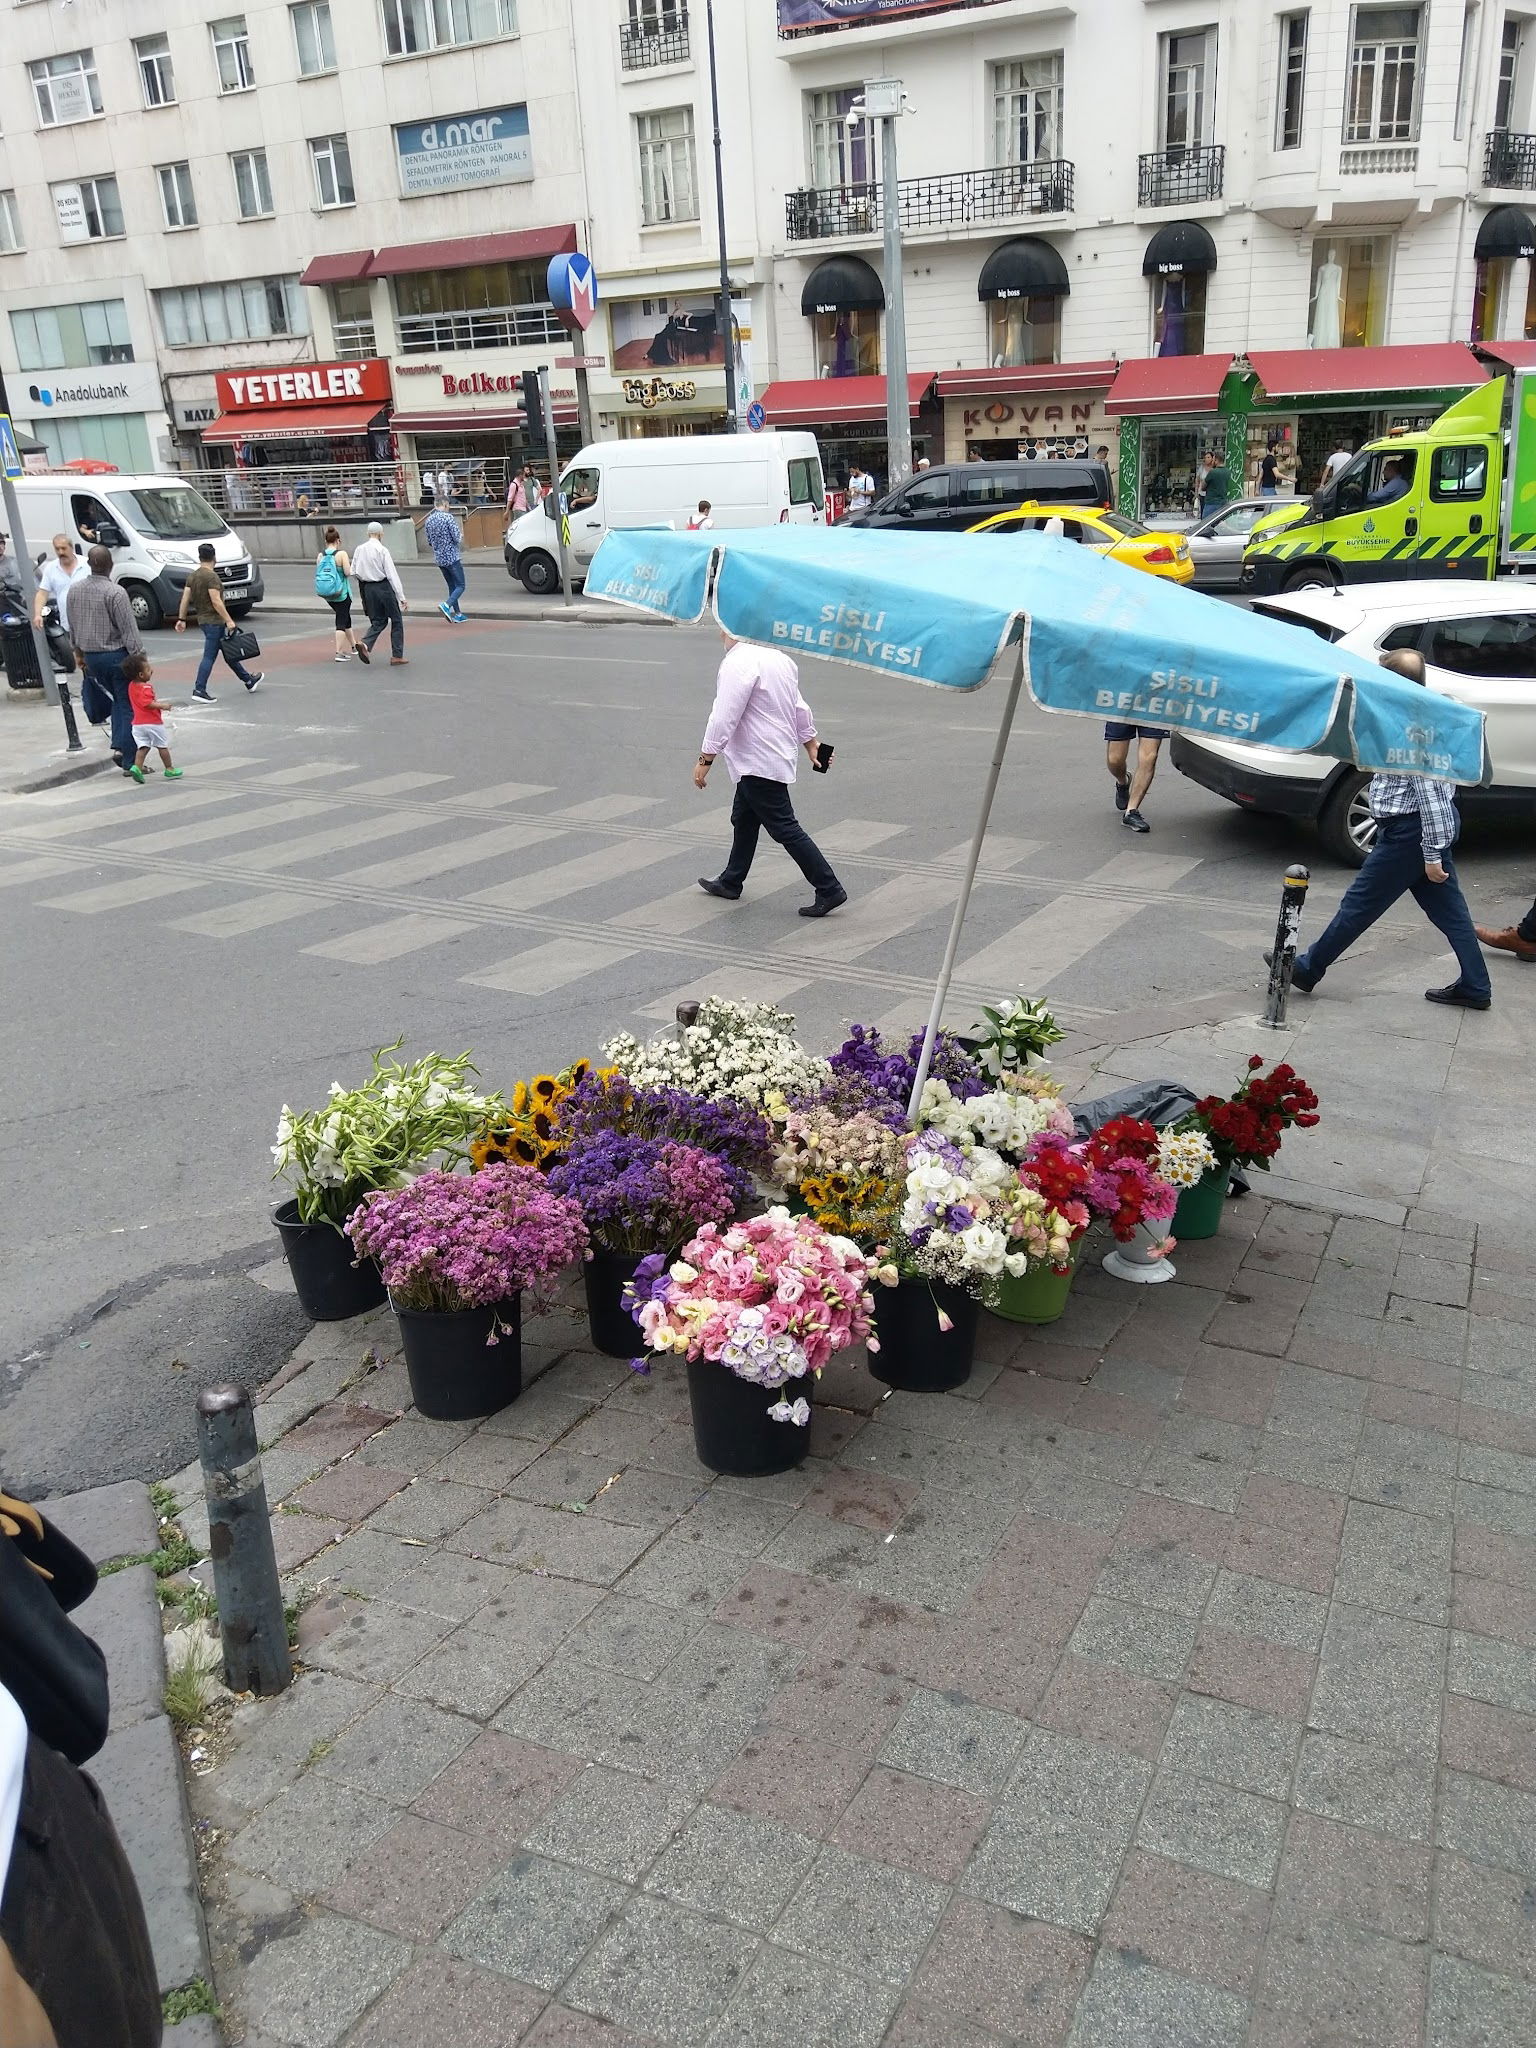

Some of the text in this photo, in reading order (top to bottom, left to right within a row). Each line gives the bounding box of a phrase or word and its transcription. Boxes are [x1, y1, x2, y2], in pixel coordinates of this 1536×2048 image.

[421, 116, 503, 150] d.mar
[405, 141, 503, 165] DENTAL PANORAMİK RÖNTGEN
[406, 161, 454, 178] SEFALOMETRİK
[454, 156, 486, 169] RÖNTGEN
[490, 152, 521, 164] PANORAL
[408, 166, 501, 189] DENTAL KILAVUZ TOMOGRAFİ
[1158, 262, 1183, 273] big boss
[997, 287, 1021, 299] big boss
[816, 303, 837, 314] big boss
[55, 382, 129, 402] Anadolubank
[228, 367, 364, 404] YETERLER
[624, 377, 696, 408] big boss
[184, 409, 216, 422] MAYA
[963, 401, 1091, 425] KOVAN
[772, 620, 923, 668] BELEDİYESİ
[1095, 688, 1261, 733] BELEDİYESİ
